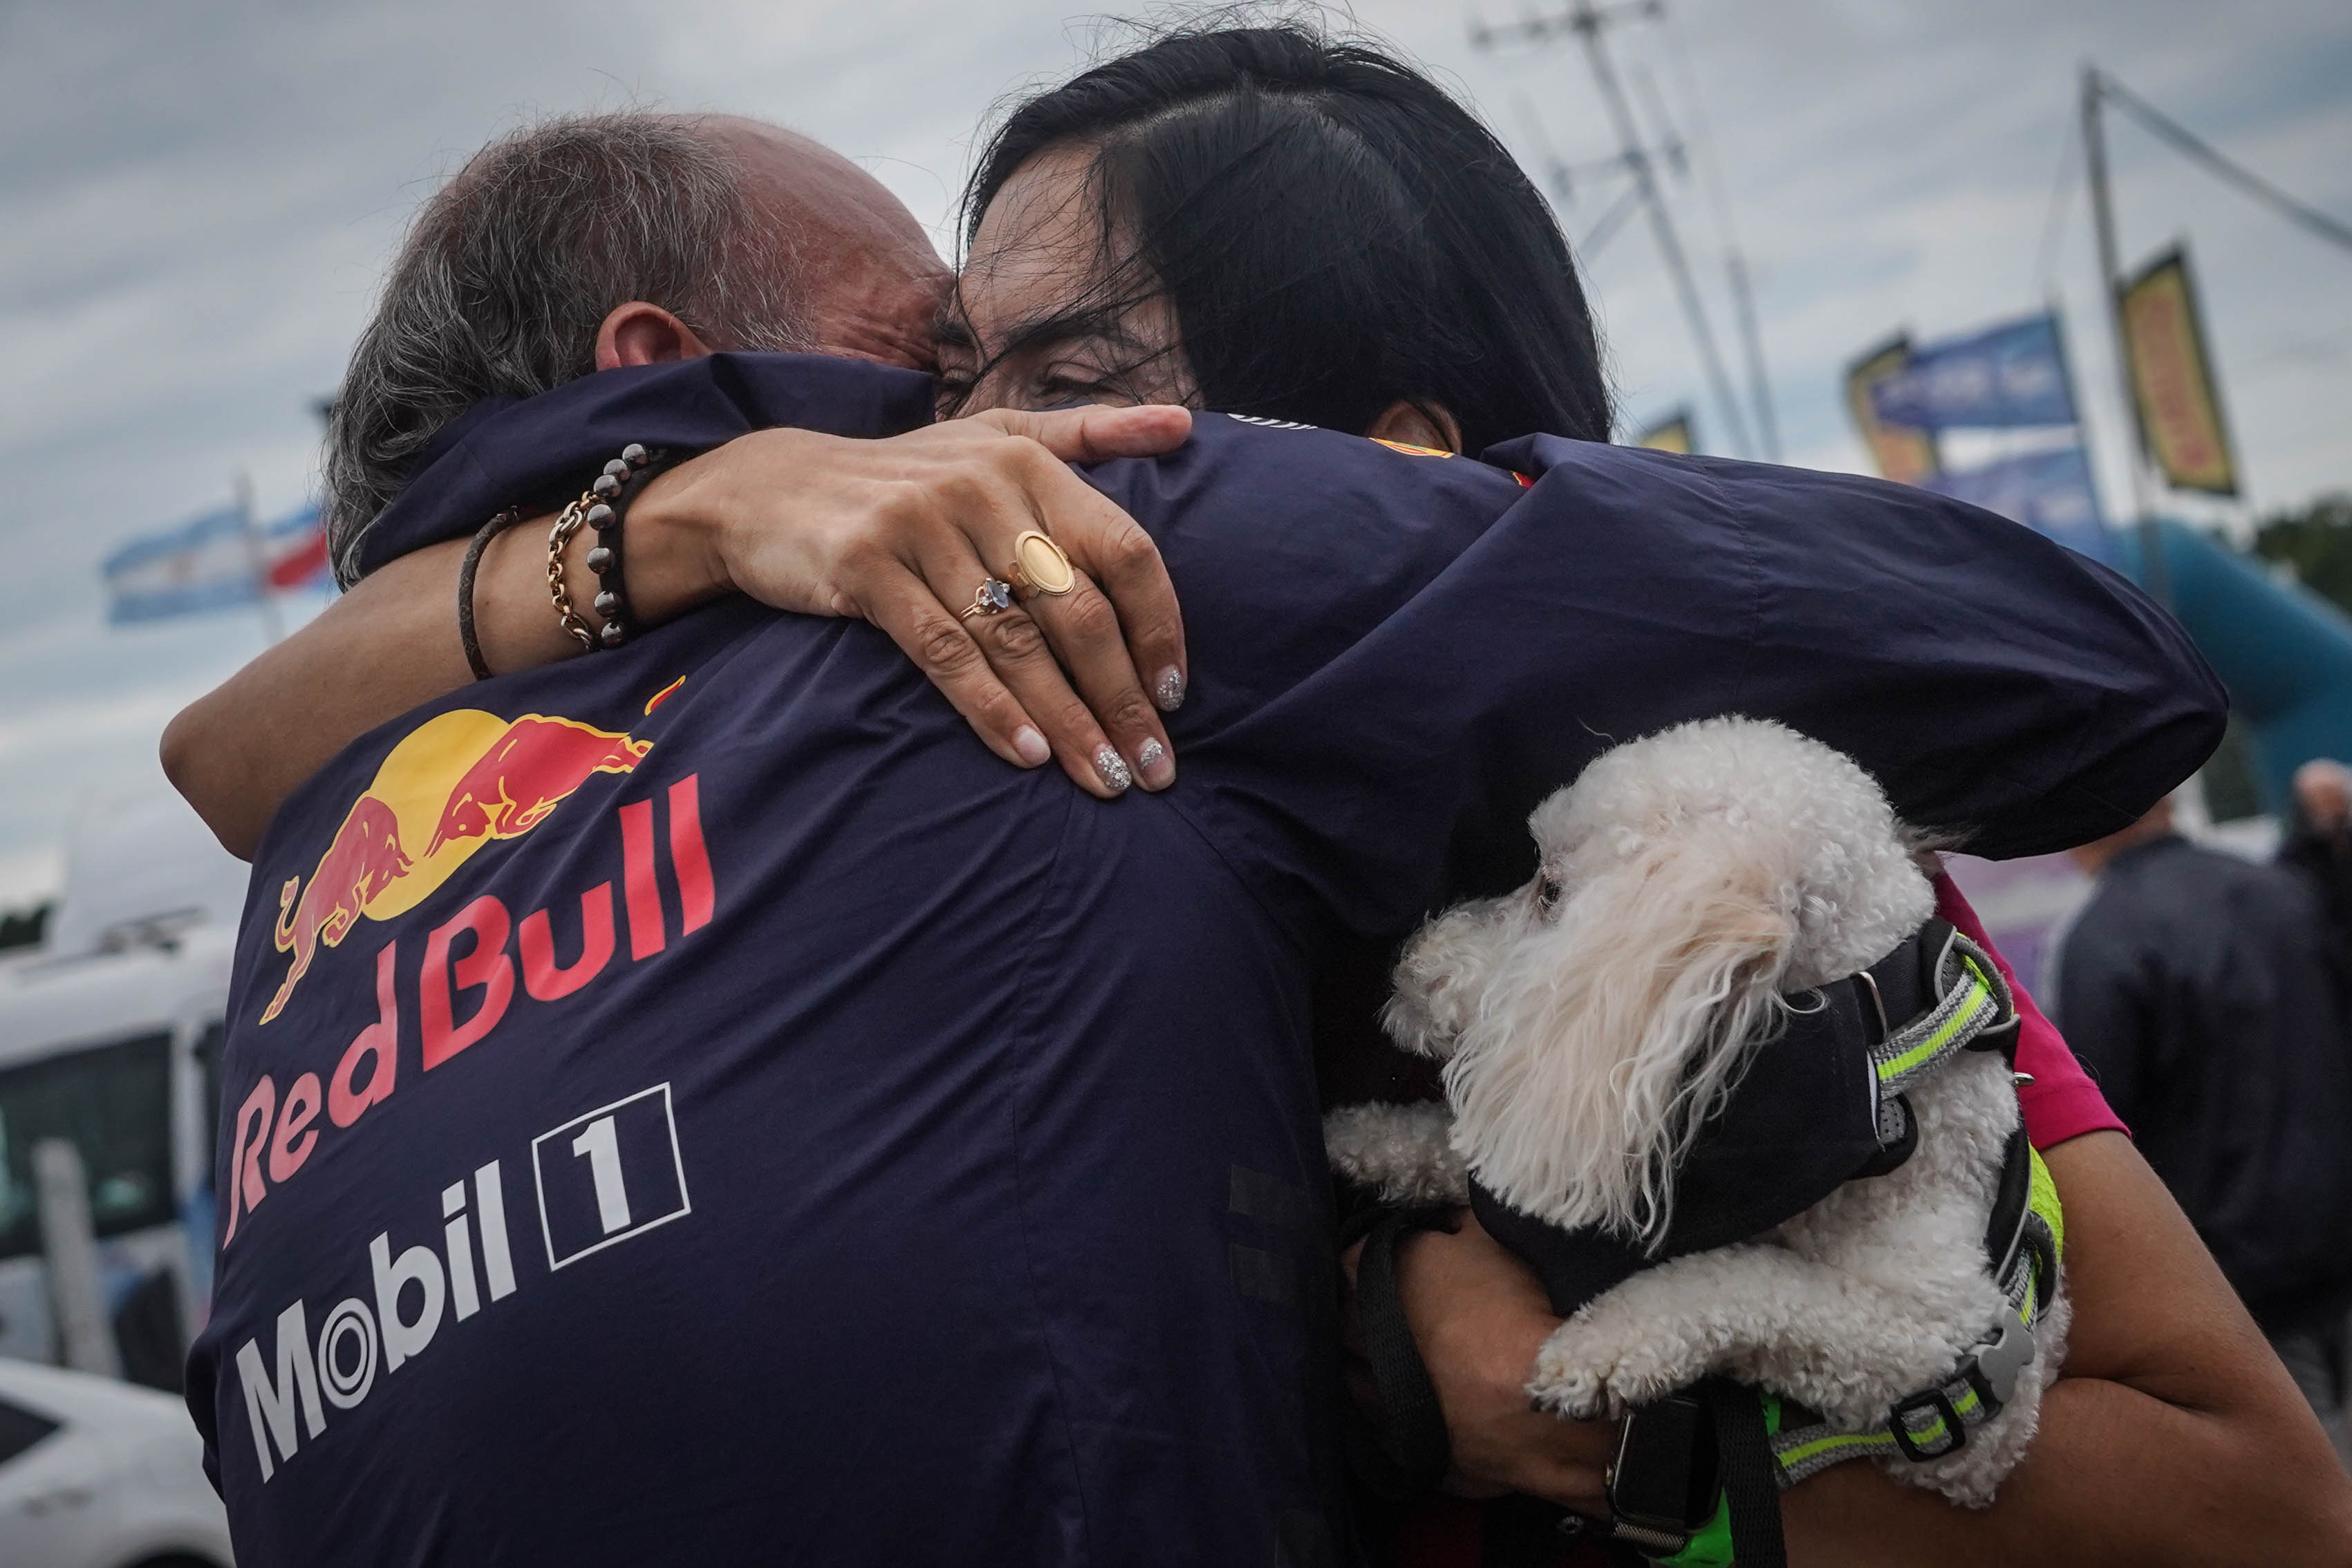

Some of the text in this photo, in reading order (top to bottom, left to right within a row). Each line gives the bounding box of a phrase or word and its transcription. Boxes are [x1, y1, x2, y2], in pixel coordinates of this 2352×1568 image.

[224, 773, 715, 1250] Red Bull
[236, 1115, 632, 1484] Mobil 1
